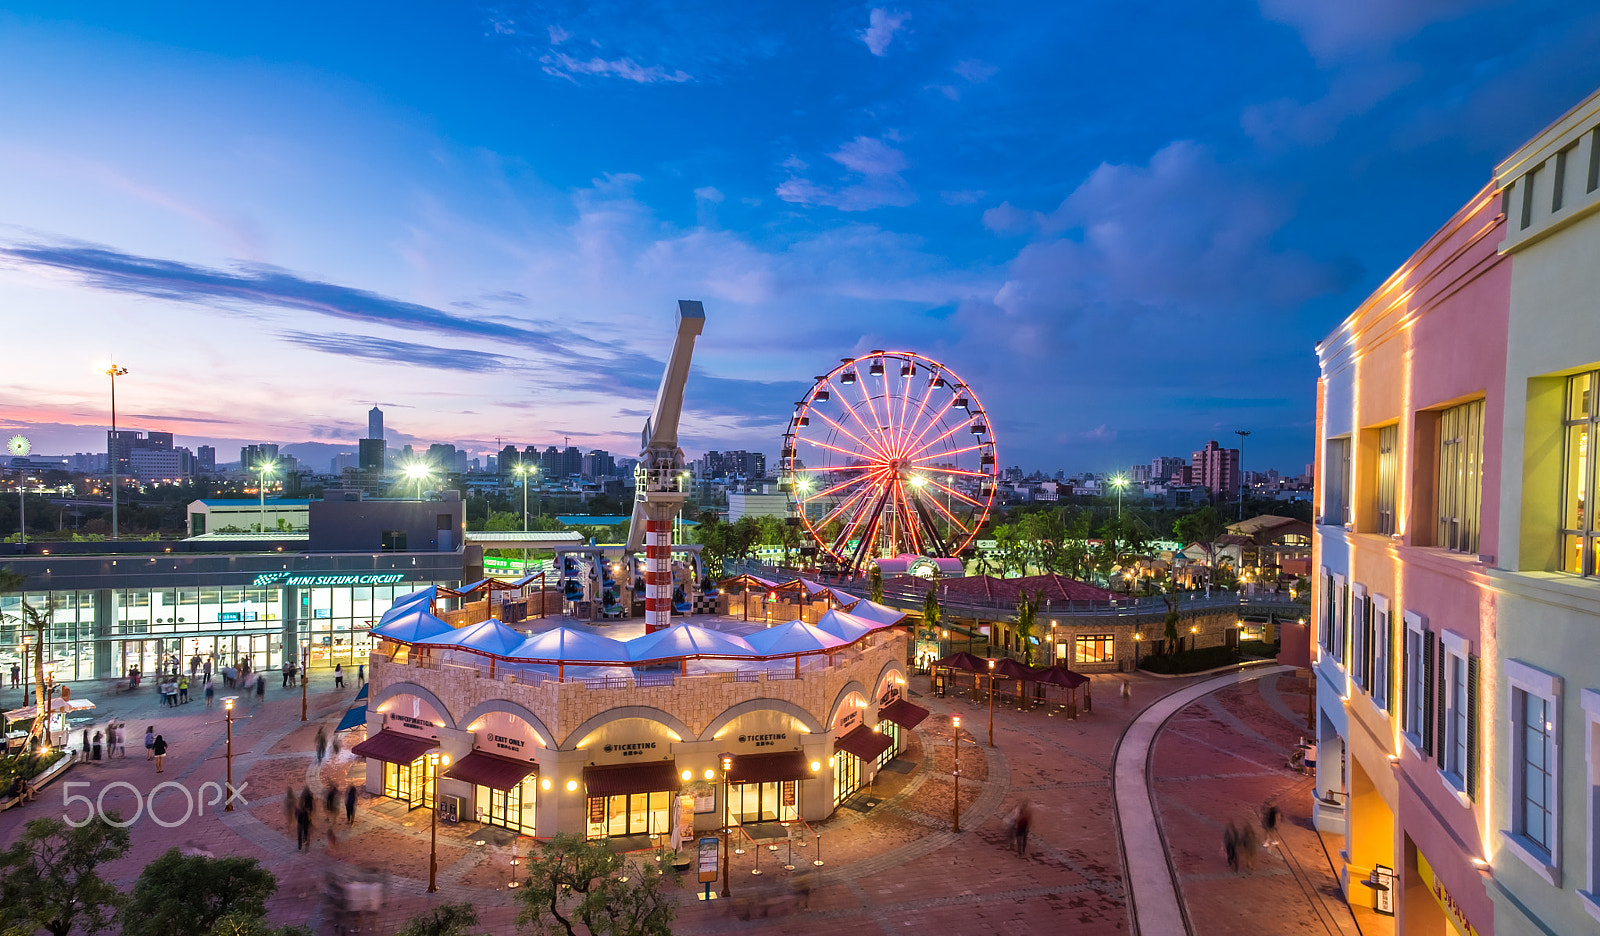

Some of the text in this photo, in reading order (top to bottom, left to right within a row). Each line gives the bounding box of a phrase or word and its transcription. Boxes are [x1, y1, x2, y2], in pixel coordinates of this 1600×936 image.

[286, 574, 404, 586] MINI SUZUKA CIRCUIT
[396, 714, 434, 727] INFORMATION
[495, 735, 525, 747] EXIT ONLY
[747, 733, 786, 742] TICKETING
[613, 742, 656, 751] TICKETING
